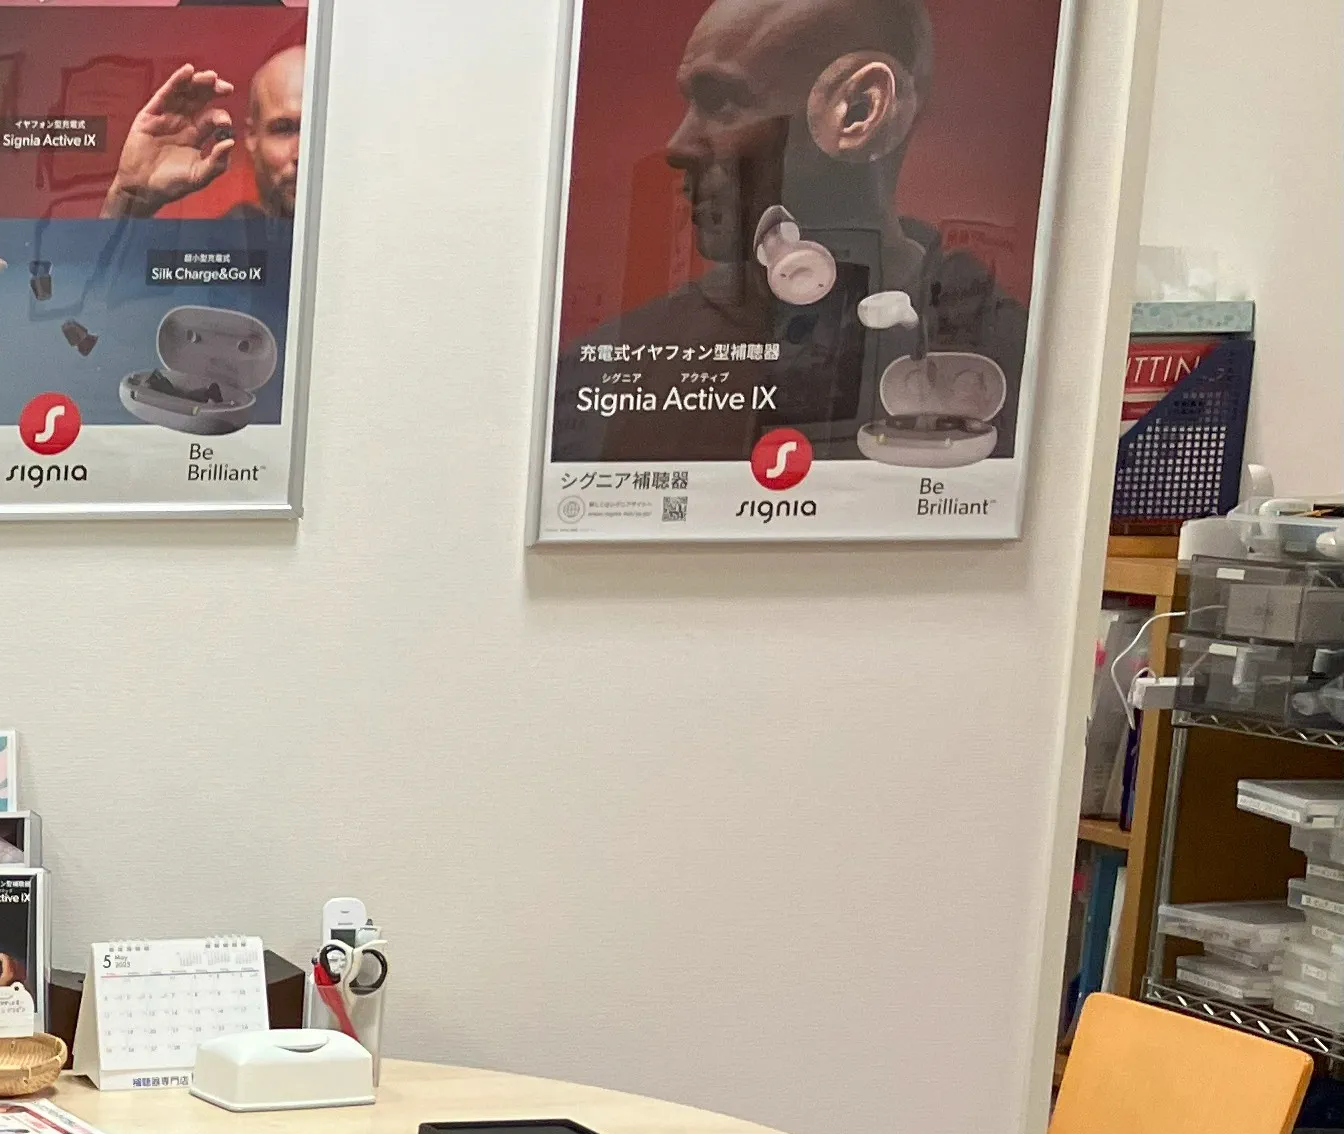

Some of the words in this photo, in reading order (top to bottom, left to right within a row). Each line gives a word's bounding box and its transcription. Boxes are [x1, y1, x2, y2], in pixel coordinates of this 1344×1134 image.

[2, 134, 41, 149] Signia
[42, 133, 82, 146] Active
[83, 133, 96, 146] IX
[151, 267, 173, 280] Silk
[175, 267, 248, 283] Charge&Go
[249, 267, 262, 280] IX
[580, 343, 780, 362] 充電式イヤフォン型補聴器
[602, 372, 642, 384] シグニア
[681, 371, 730, 383] アクティブ
[576, 386, 657, 417] Signia
[662, 386, 746, 411] Active
[752, 385, 778, 410] IX
[189, 443, 214, 460] Be
[5, 464, 88, 488] signia
[561, 471, 689, 490] シグニア補聴器
[919, 477, 944, 494] Be
[735, 499, 817, 524] signia
[102, 954, 111, 968] 5
